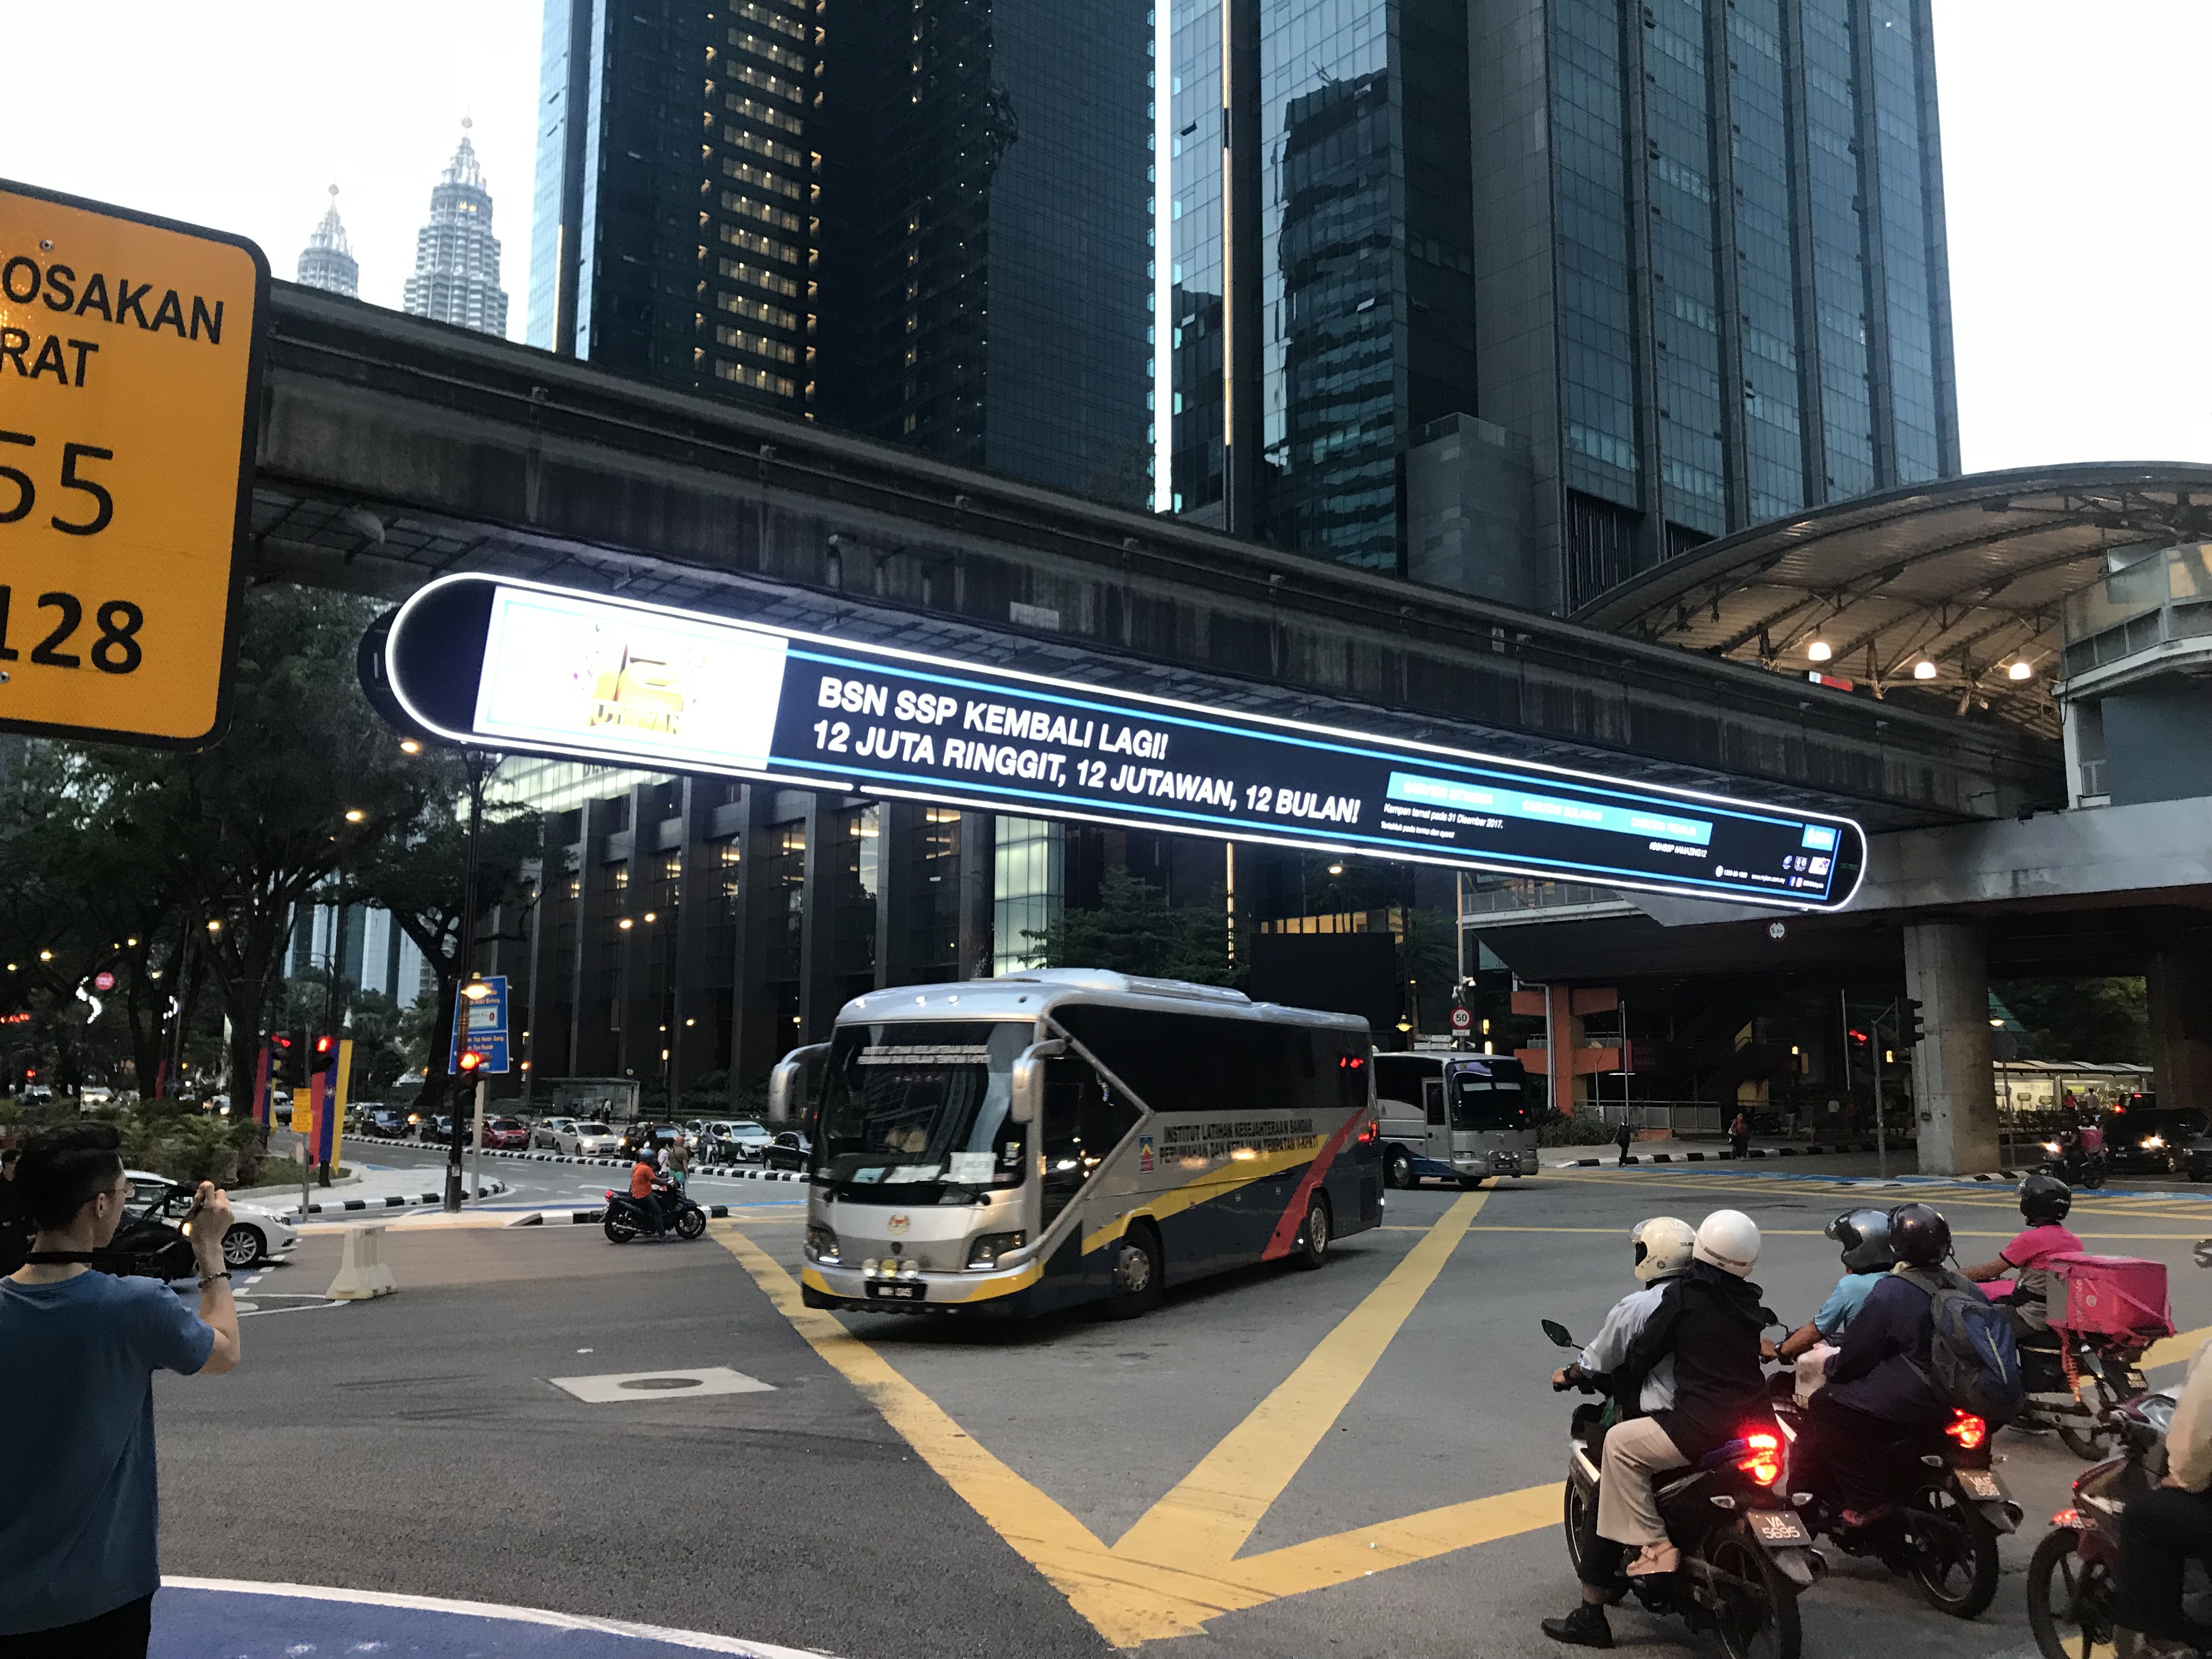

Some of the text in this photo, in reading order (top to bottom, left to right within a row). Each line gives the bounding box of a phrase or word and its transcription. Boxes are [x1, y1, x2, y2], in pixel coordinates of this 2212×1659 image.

[2, 256, 224, 345] OSAKAN
[0, 327, 99, 387] RAT
[817, 675, 1169, 760] BSN SSP KEMBALI LAGI!
[813, 719, 1362, 824] 12 JUTA RINGGIT, 12 JUTAWAN, 12 BULAN!
[1430, 811, 1447, 822] pada
[1447, 812, 1456, 822] 31
[1455, 1013, 1468, 1023] 50
[1762, 1526, 1801, 1539] 5695
[1765, 1516, 1786, 1528] VA
